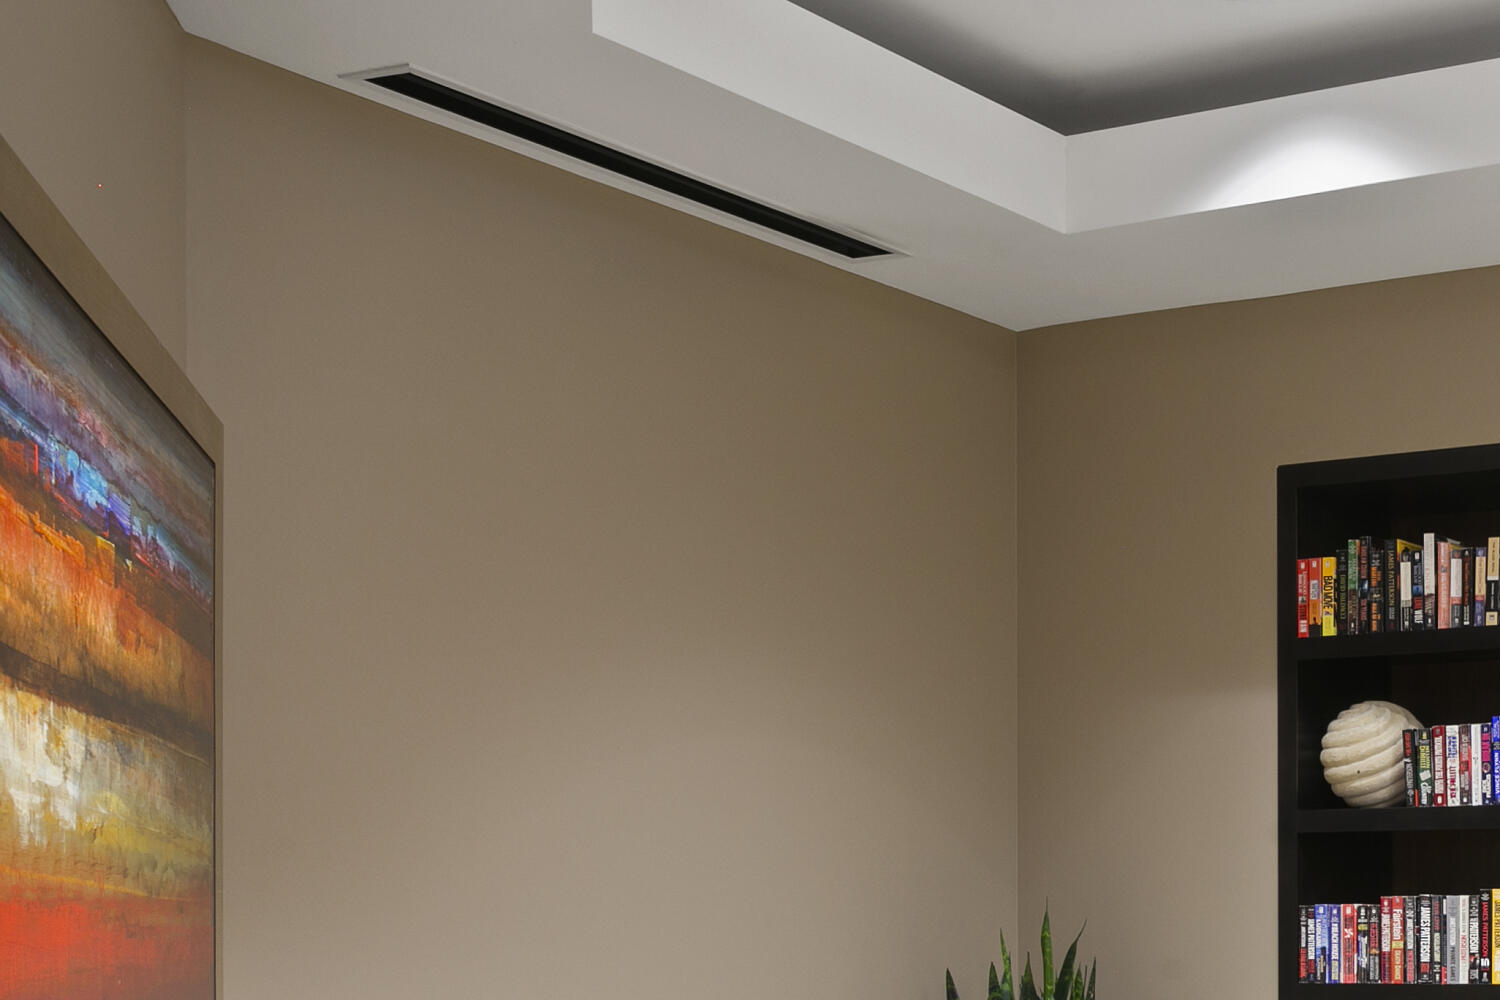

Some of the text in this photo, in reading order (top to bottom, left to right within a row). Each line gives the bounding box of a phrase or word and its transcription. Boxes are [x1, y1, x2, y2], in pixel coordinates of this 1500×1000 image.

[1324, 575, 1333, 609] BAD MOVE
[1393, 909, 1402, 940] Fairstein
[1421, 906, 1431, 962] JAMES PATTERSON
[1481, 902, 1489, 957] JAMES PATTERSON
